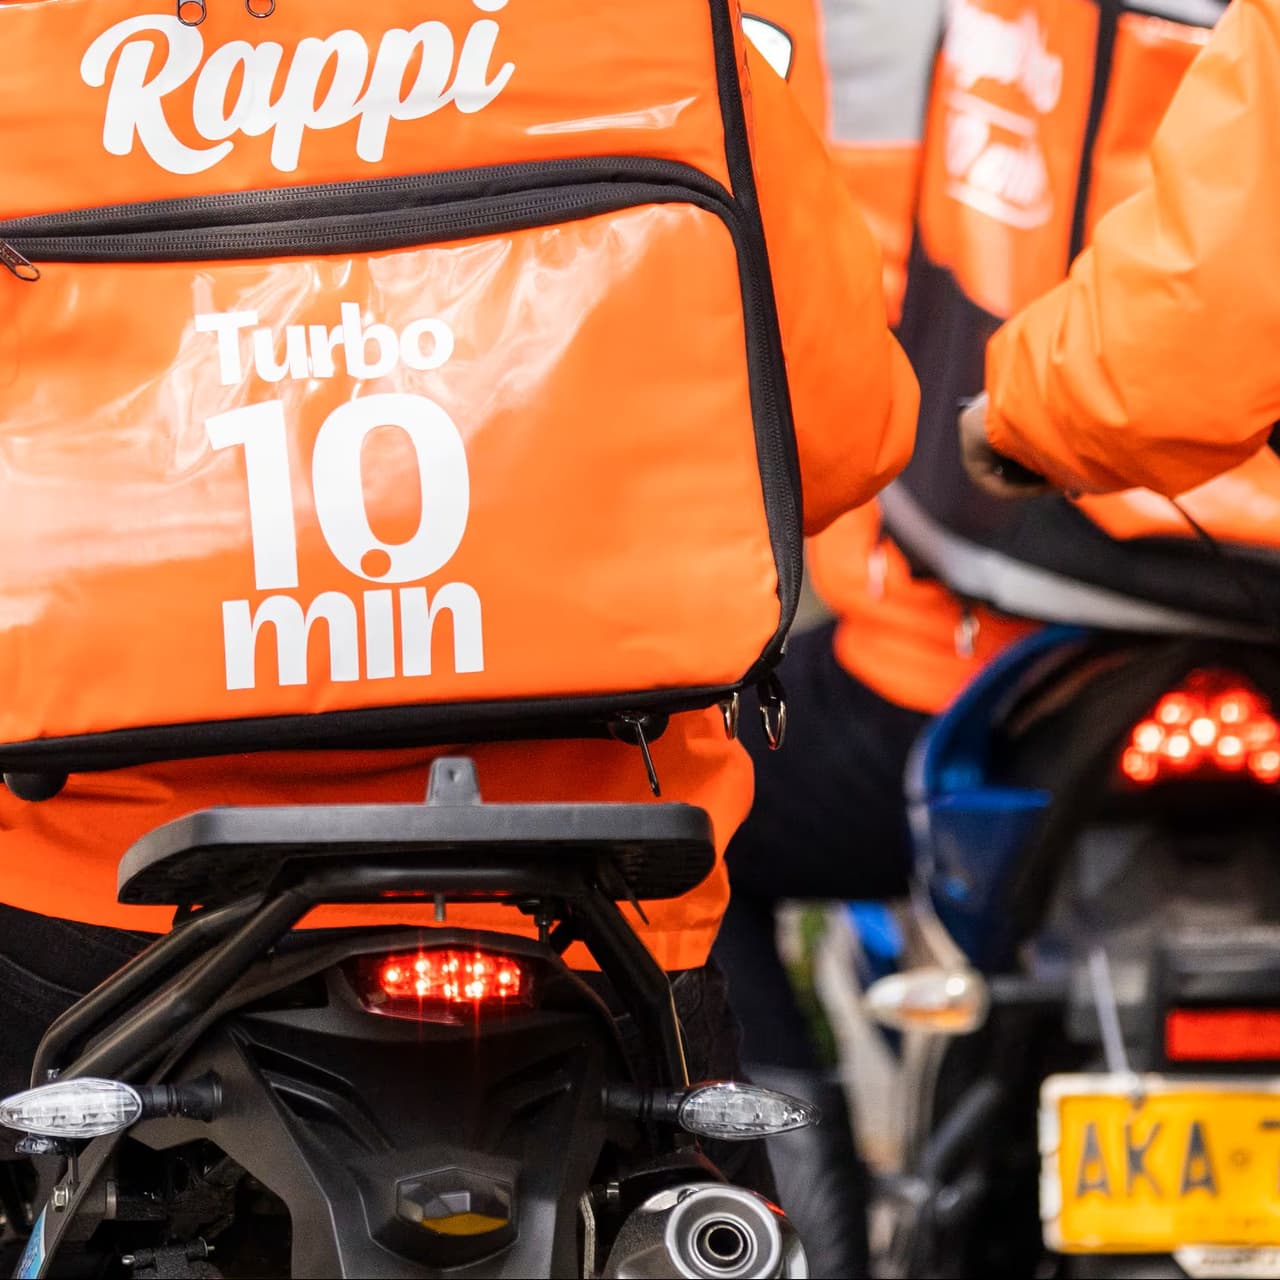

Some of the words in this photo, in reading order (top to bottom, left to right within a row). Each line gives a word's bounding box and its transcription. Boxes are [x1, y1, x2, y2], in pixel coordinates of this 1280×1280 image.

[195, 302, 455, 387] Turbo
[205, 392, 471, 591] 10
[221, 581, 485, 691] min
